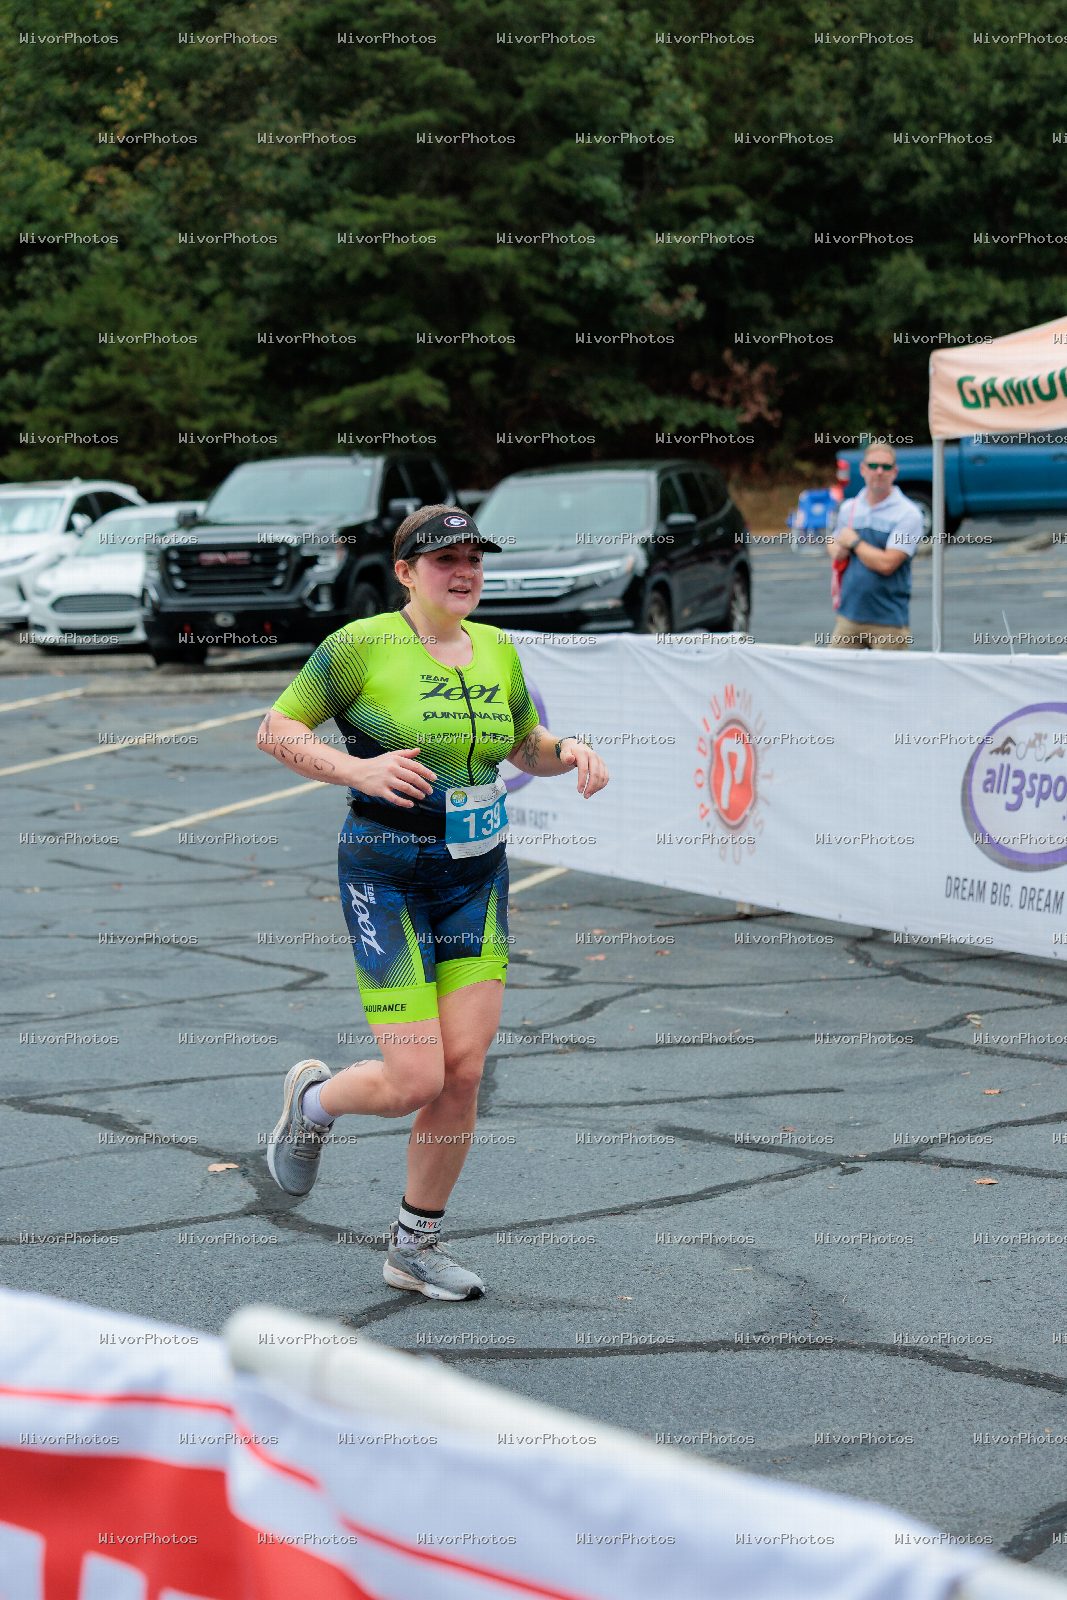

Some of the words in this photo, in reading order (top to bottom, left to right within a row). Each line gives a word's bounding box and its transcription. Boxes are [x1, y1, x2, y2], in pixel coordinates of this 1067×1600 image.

[420, 674, 450, 683] TEAM
[463, 802, 500, 839] 139
[945, 875, 987, 903] DREAM
[990, 881, 1013, 908] BIG.
[1019, 885, 1065, 915] DREAM
